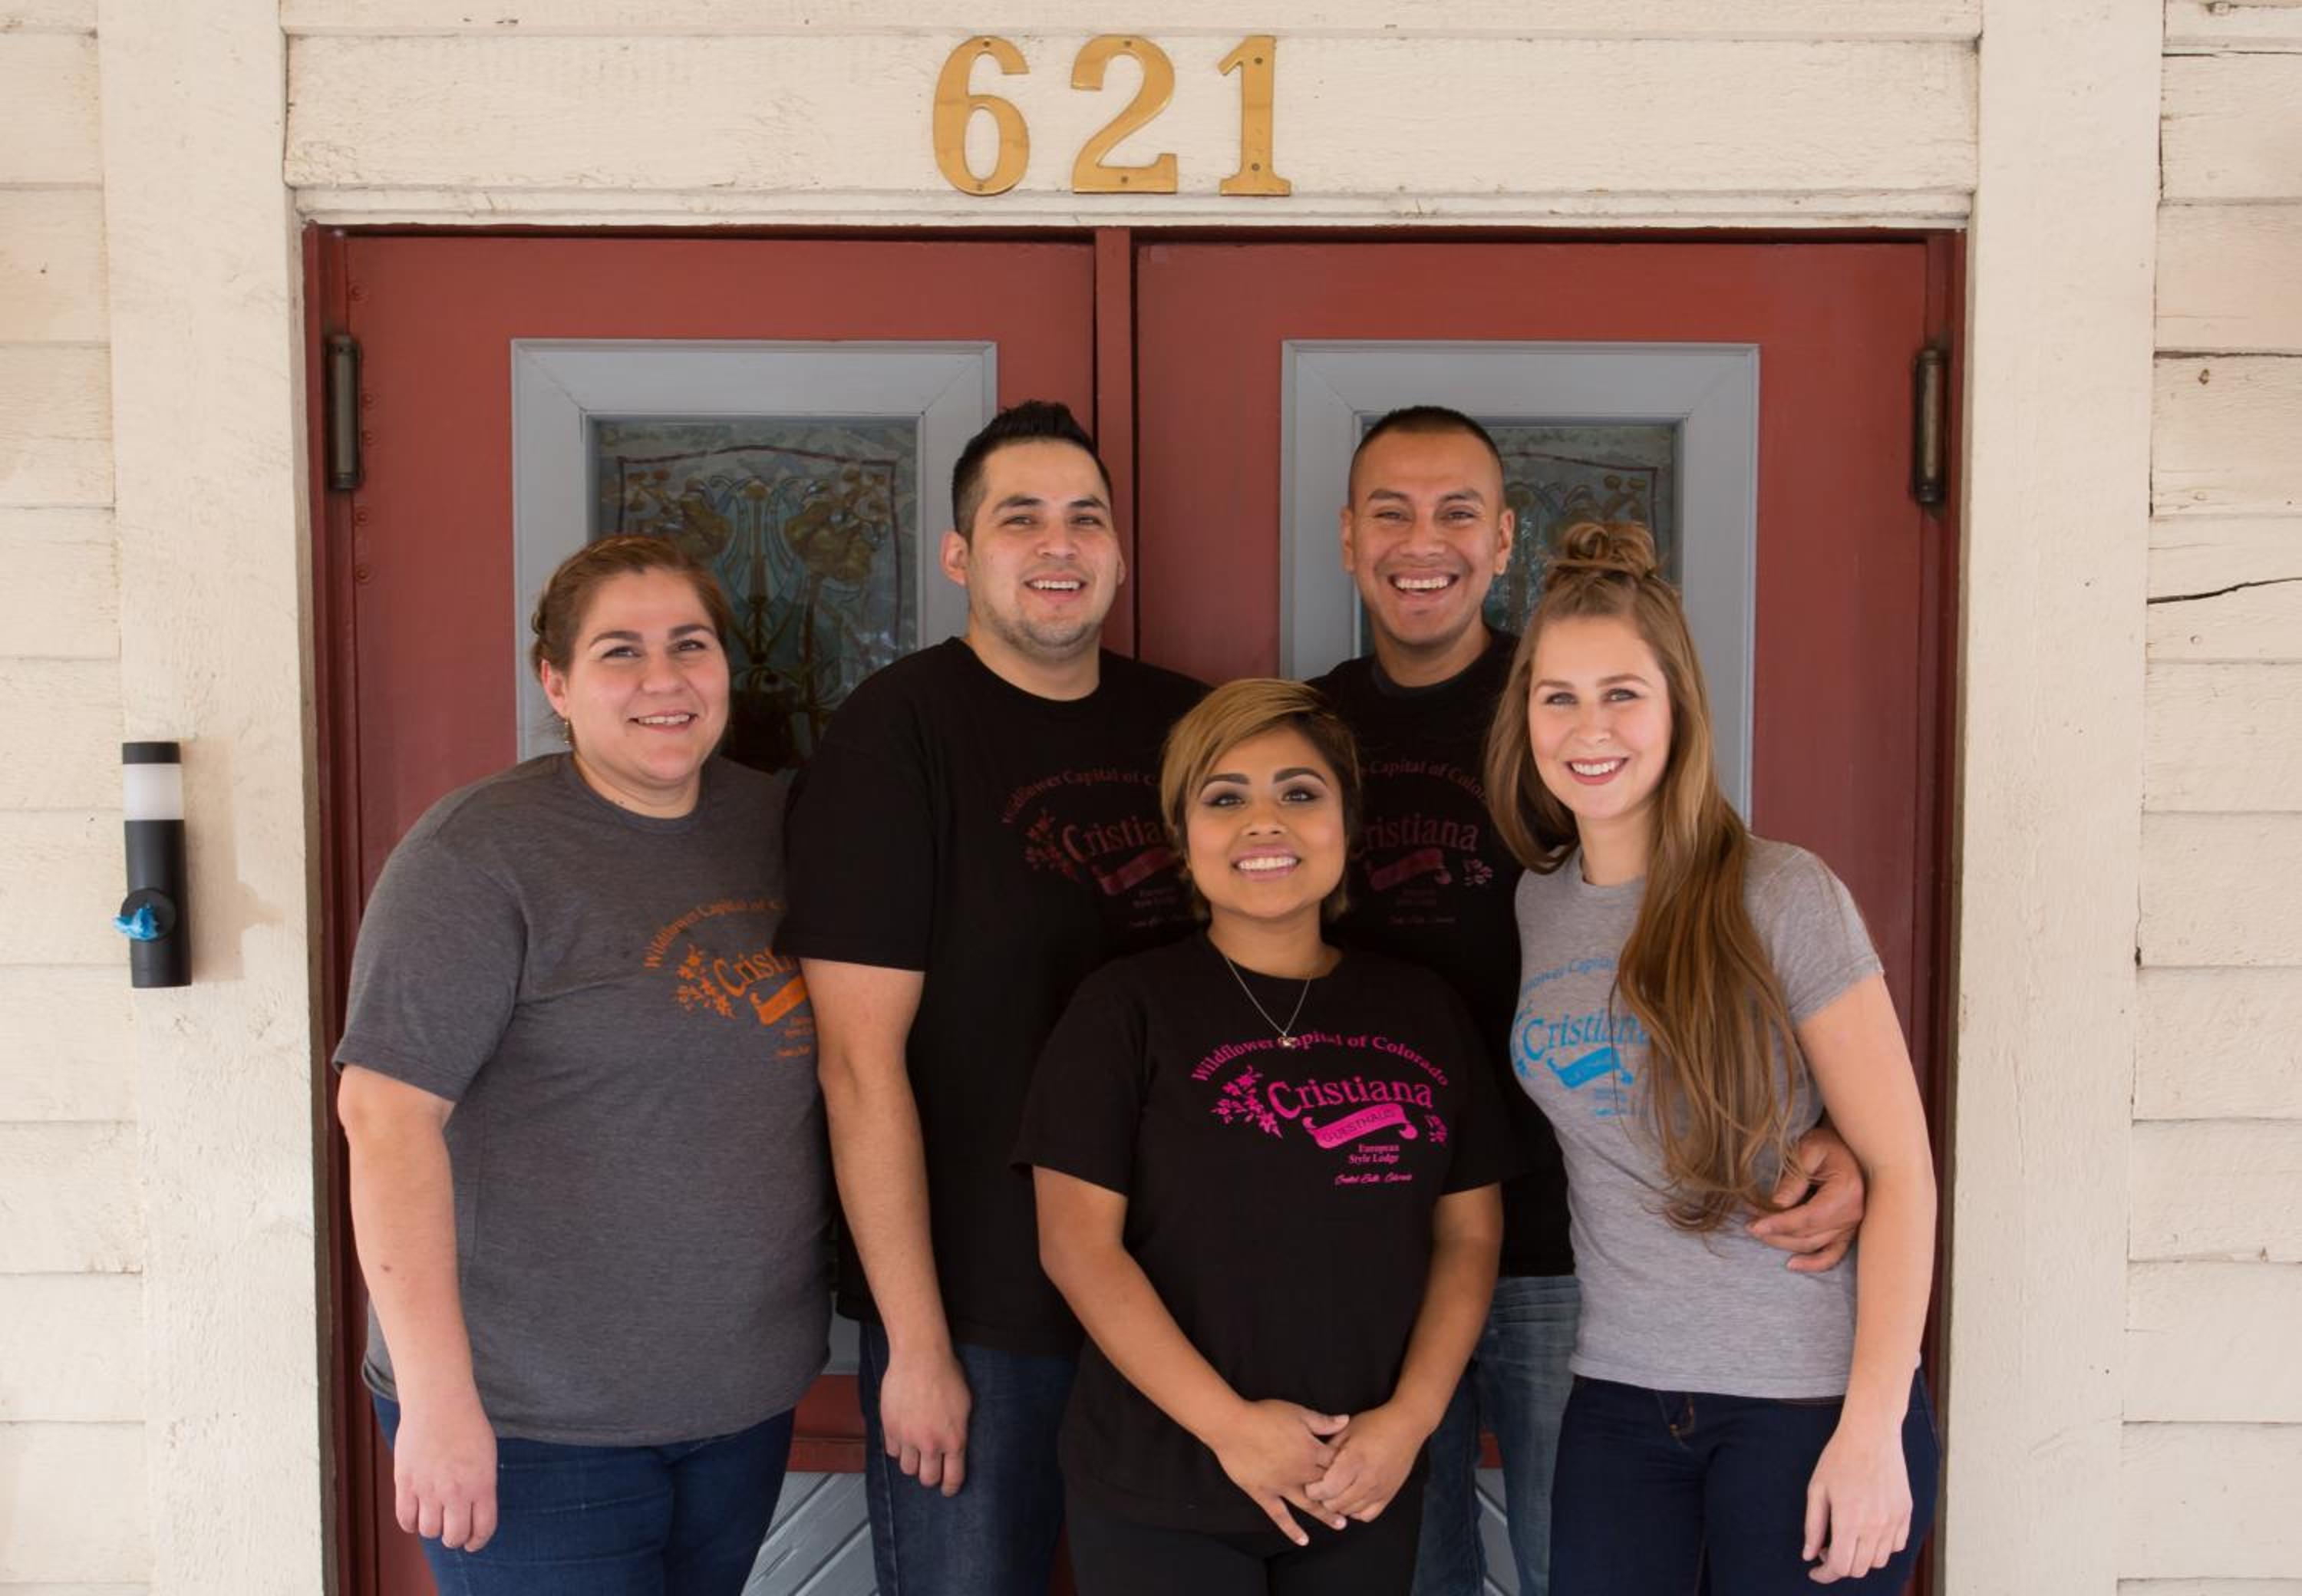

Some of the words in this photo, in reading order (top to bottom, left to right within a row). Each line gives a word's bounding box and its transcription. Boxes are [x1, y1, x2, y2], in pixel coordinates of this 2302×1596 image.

[932, 34, 1291, 196] 621
[1061, 815, 1165, 863] Cristia
[1354, 812, 1479, 859] ristiana
[1191, 1037, 1275, 1081] Wildflower
[1347, 1035, 1367, 1048] of
[1371, 1036, 1449, 1087] Colorado
[1268, 1076, 1433, 1119] Cristiana
